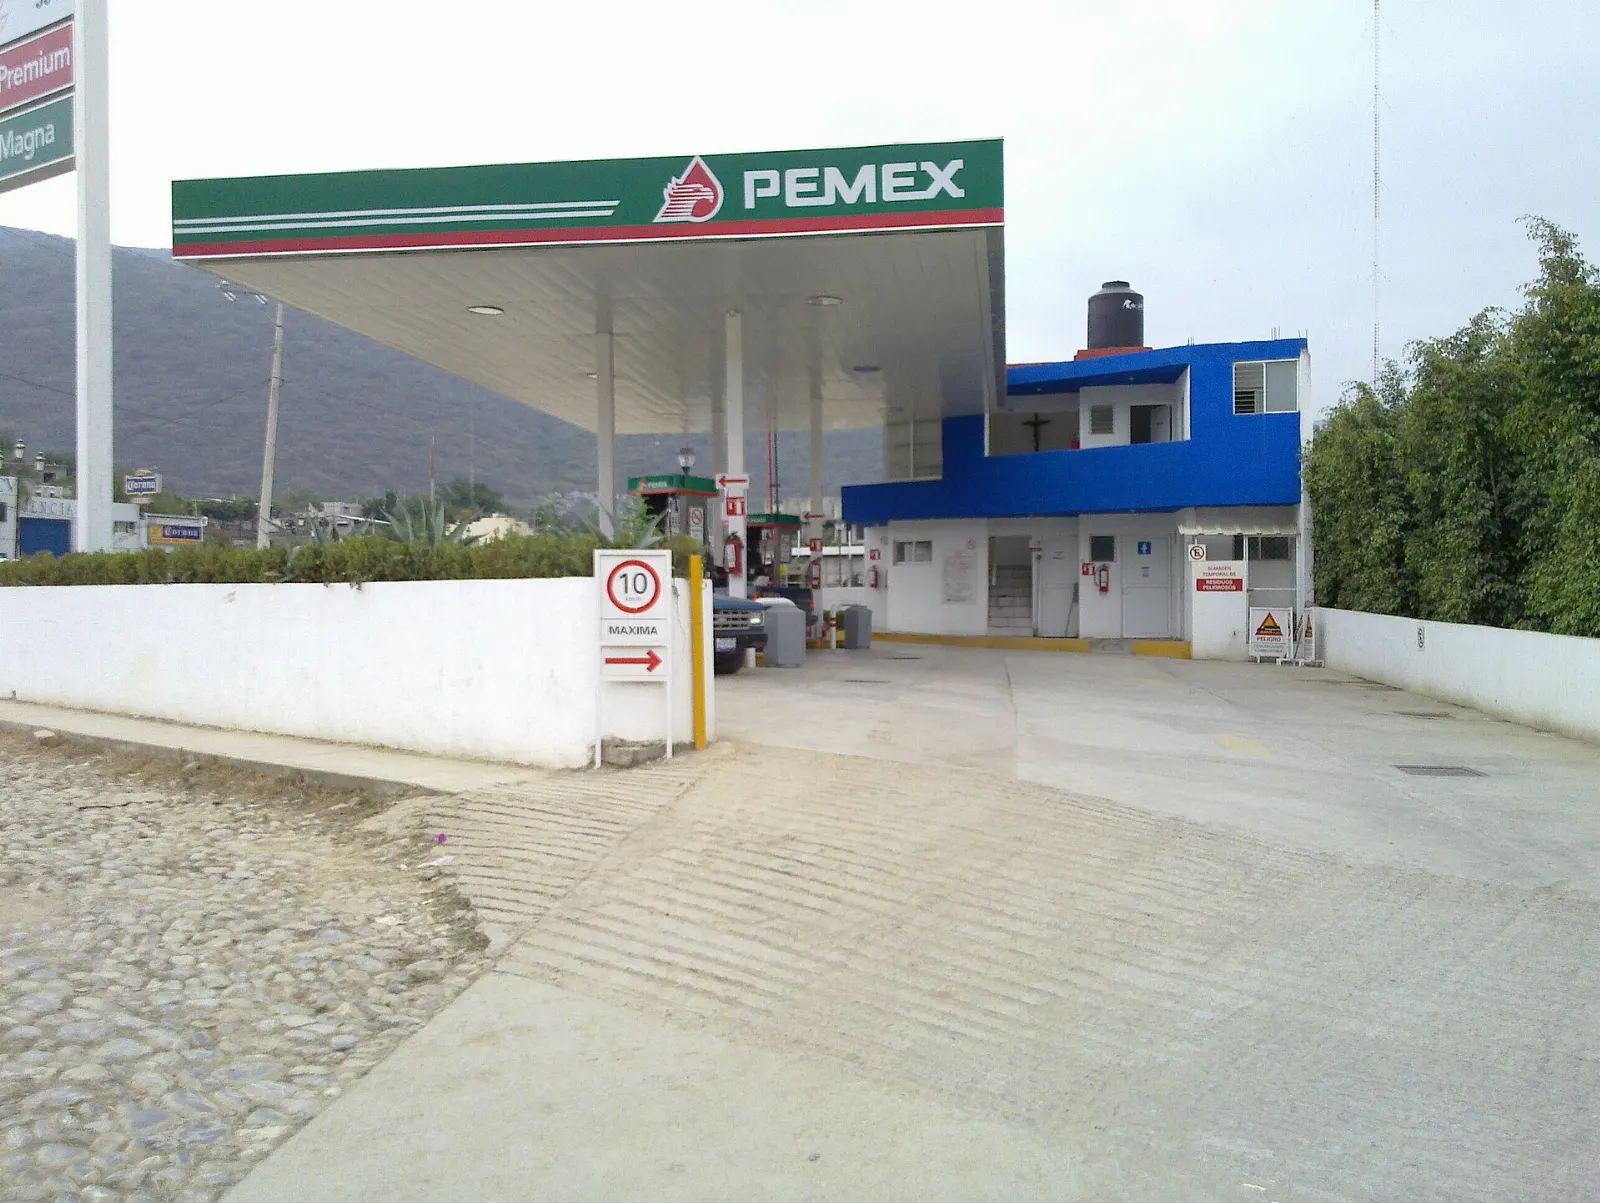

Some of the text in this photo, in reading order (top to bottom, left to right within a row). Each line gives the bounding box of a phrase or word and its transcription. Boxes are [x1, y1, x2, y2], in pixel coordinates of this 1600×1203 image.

[0, 47, 70, 92] Premium
[0, 124, 55, 162] Magna
[743, 159, 965, 209] PEMEX
[127, 480, 156, 491] Corona
[164, 526, 199, 537] Corona
[619, 572, 648, 594] 10
[609, 625, 658, 635] MAXIMA
